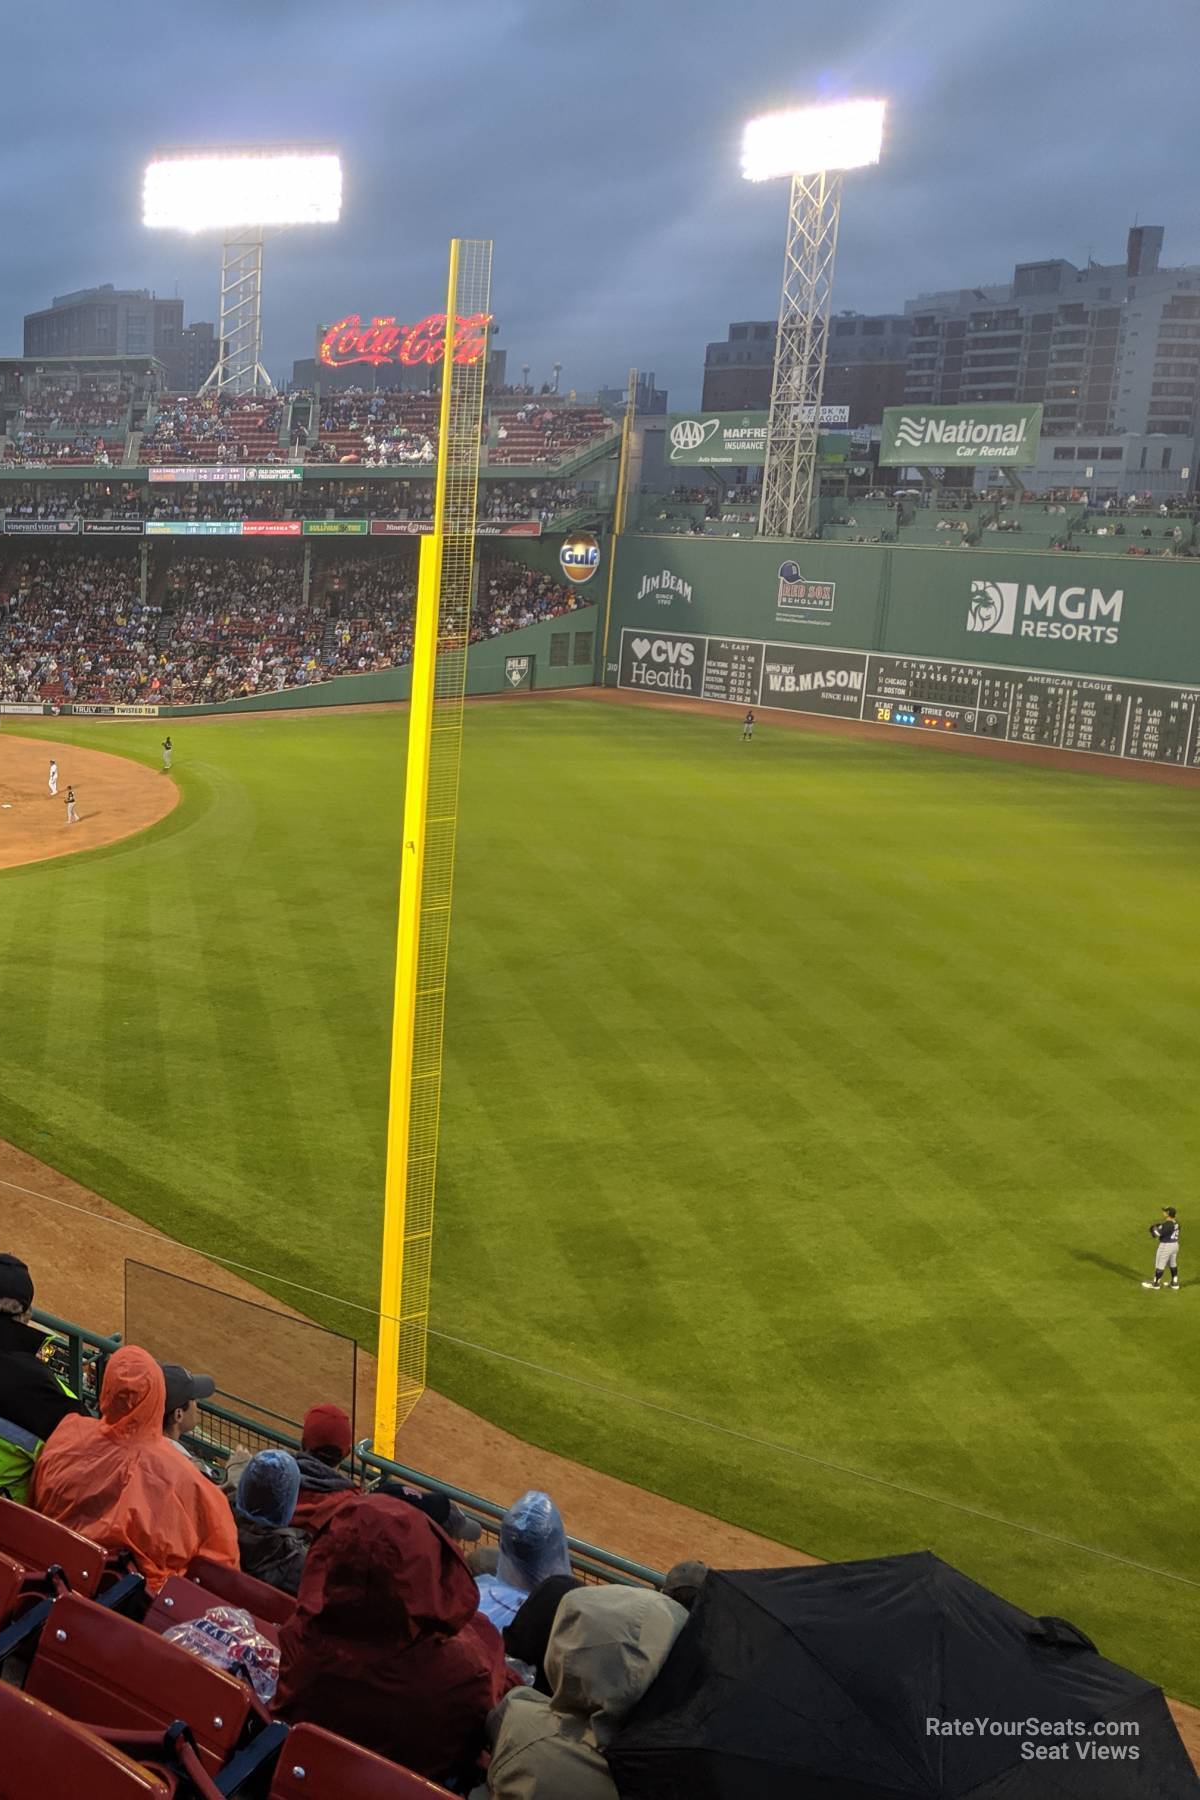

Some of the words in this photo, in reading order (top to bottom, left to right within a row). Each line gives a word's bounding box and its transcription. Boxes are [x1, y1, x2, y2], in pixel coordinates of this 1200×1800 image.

[674, 421, 700, 448] AAA
[723, 428, 768, 438] MAPFRE
[724, 441, 764, 449] INSURANCE
[956, 446, 978, 456] Car
[979, 446, 1019, 456] Rental
[7, 522, 37, 531] vineyard
[561, 546, 598, 565] Gulf
[637, 574, 660, 599] JIM
[661, 569, 692, 603] BEAM
[782, 584, 805, 598] RED
[807, 586, 831, 599] SOX
[782, 597, 830, 606] SCHOLARS
[1023, 584, 1124, 622] MGM
[1021, 620, 1119, 644] RESORTS
[651, 639, 695, 666] CVS
[507, 658, 528, 669] MLB
[607, 663, 618, 671] 310
[765, 664, 780, 673] WHO
[781, 664, 794, 674] BUT
[895, 661, 942, 672] FENWAY
[951, 667, 982, 676] PARK
[631, 662, 692, 690] Health
[885, 677, 907, 686] CHICAGO
[1027, 676, 1073, 687] AMERICAN
[1077, 681, 1113, 691] LEAGUE
[705, 683, 726, 691] TORONTO
[884, 687, 906, 696] BOSTON
[703, 691, 727, 699] BALTIMORE
[821, 692, 841, 700] SINCE
[1025, 702, 1039, 710] BAL
[1170, 701, 1179, 709] IN
[877, 708, 891, 720] 28
[899, 704, 914, 712] BALL
[921, 707, 942, 716] STRIKE
[945, 710, 959, 718] OUT
[1081, 709, 1096, 717] HOU
[1147, 709, 1162, 717] LAD
[1024, 717, 1037, 725] NYY
[1147, 717, 1161, 725] ARI
[1145, 725, 1159, 734] ATL
[1022, 733, 1036, 741] CLE
[1143, 733, 1159, 741] CHC
[1077, 740, 1091, 748] DET
[1143, 749, 1156, 758] PHI
